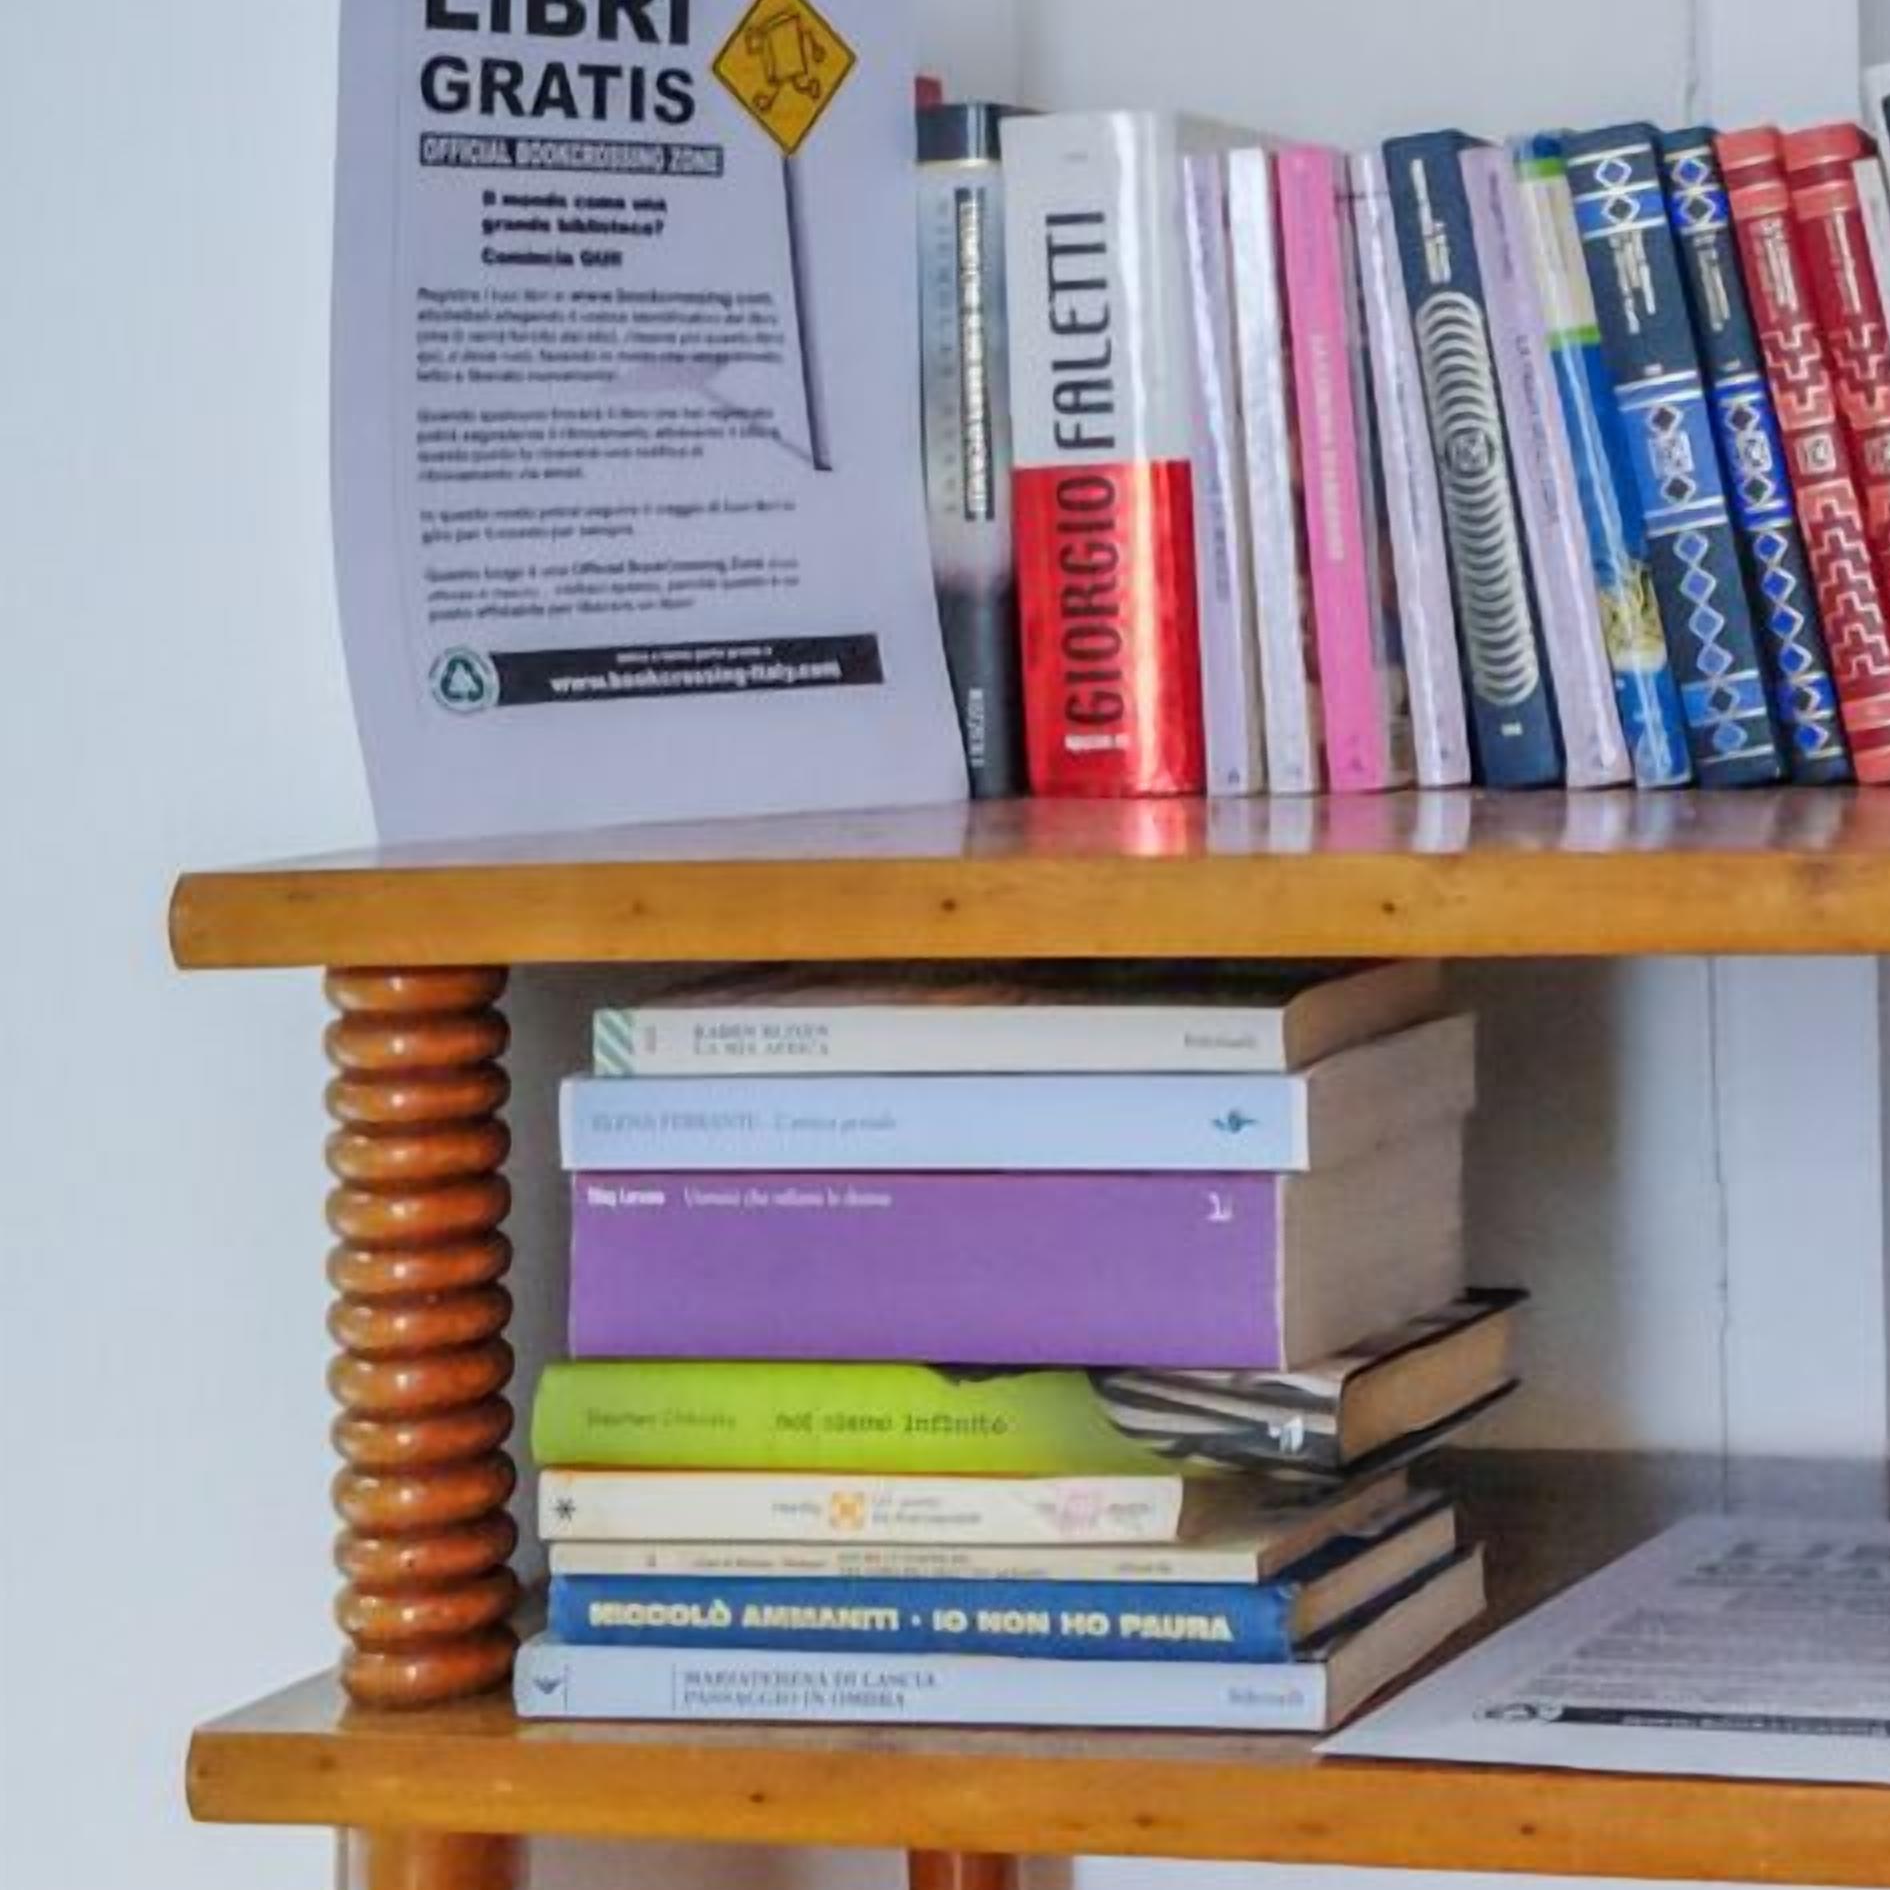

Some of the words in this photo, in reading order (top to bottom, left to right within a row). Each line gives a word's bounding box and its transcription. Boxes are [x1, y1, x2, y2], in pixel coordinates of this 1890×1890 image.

[419, 54, 697, 125] GRATIS
[424, 137, 511, 164] OFFICIAL
[671, 147, 719, 174] ZONE
[482, 217, 551, 236] grande
[1045, 211, 1115, 452] FALETTI
[1056, 474, 1124, 728] GIORGIO
[589, 1597, 732, 1628] NICCOLÒ
[741, 1603, 899, 1632] AMMANITI
[932, 1609, 968, 1633] IO
[976, 1609, 1050, 1635] NON
[1059, 1611, 1111, 1638] HO
[1118, 1613, 1235, 1643] PAURA
